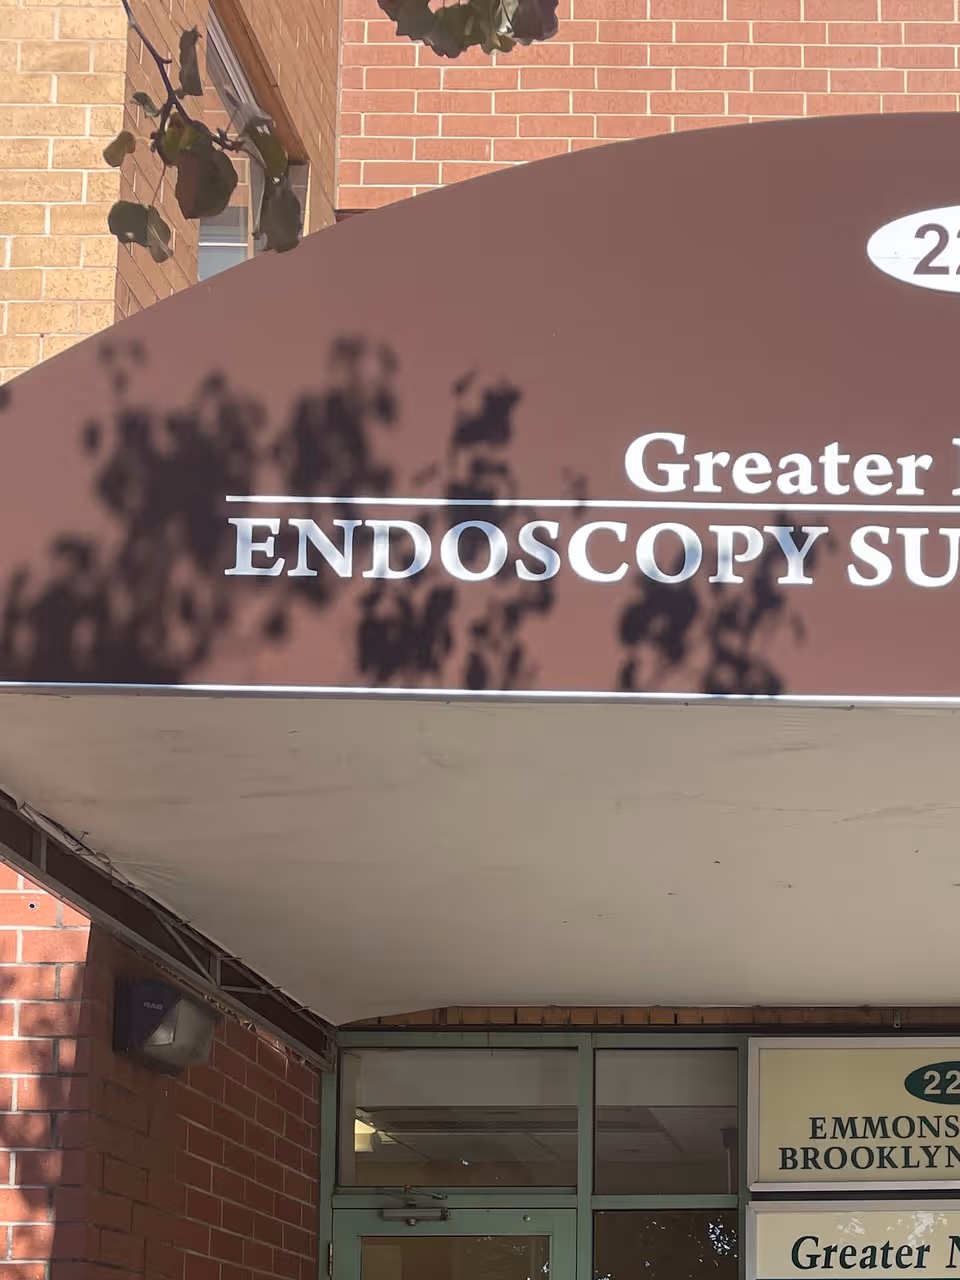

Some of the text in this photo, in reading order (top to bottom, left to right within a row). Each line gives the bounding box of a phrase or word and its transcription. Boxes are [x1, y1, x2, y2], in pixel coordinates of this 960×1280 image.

[625, 433, 932, 495] Greater
[225, 518, 828, 584] ENDOSCOPY
[809, 1115, 960, 1139] EMMONS
[791, 1235, 931, 1269] Greater
